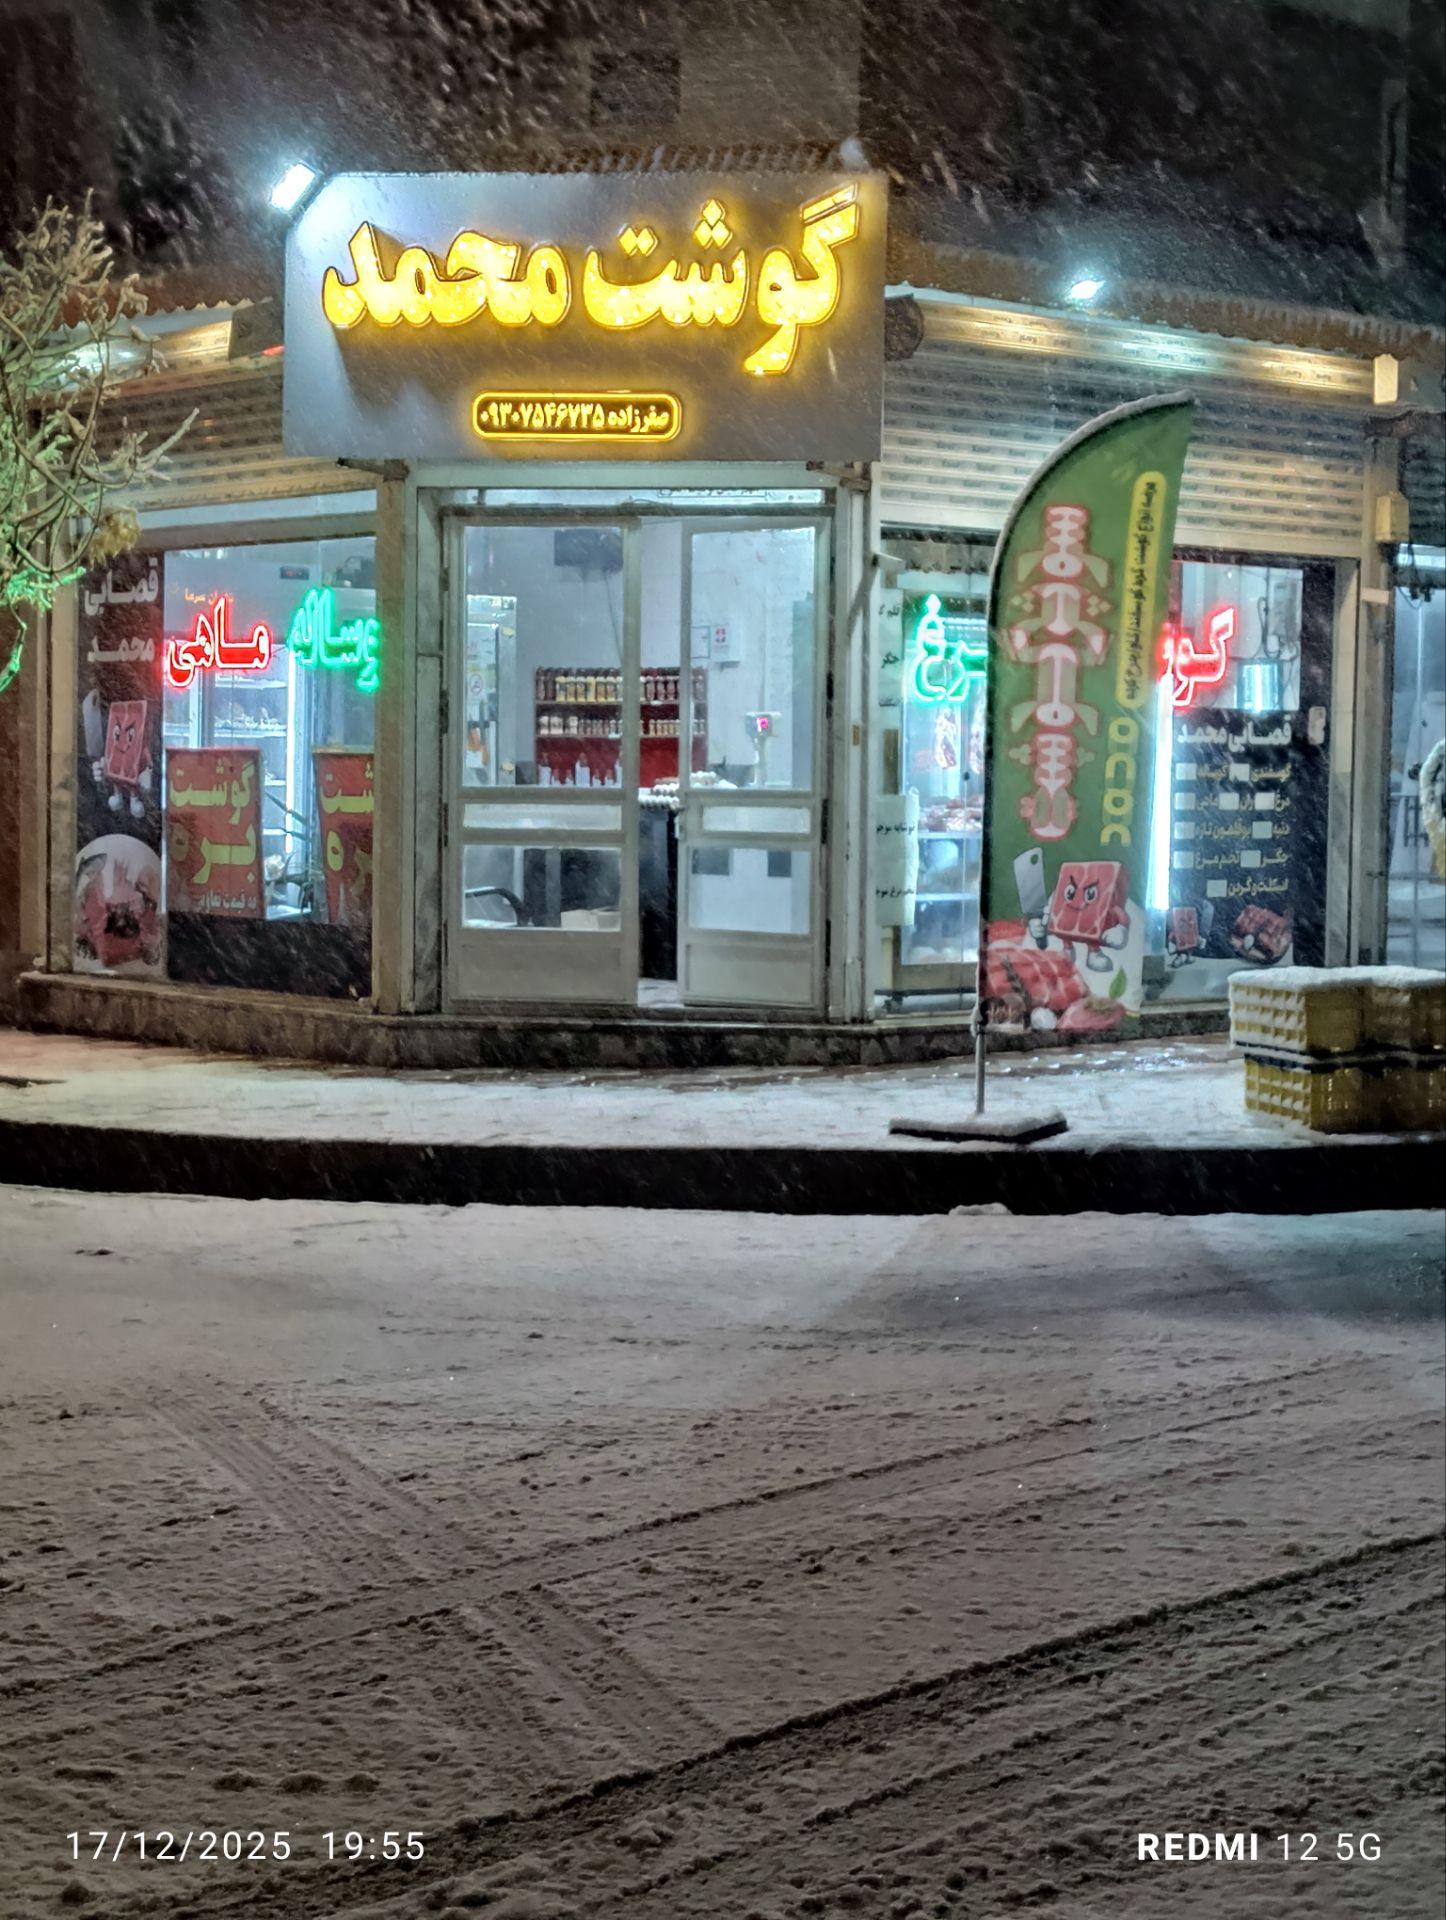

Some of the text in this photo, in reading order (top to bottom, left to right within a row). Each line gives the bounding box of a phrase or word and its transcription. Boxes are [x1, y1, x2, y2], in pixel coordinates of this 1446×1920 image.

[322, 221, 570, 327] محمد
[583, 182, 860, 376] گوشت
[85, 557, 159, 616] قصابی
[86, 635, 156, 663] محمد
[166, 596, 270, 687] ماهی
[1176, 714, 1292, 752] قصابی محمد
[169, 758, 256, 825] گوشت
